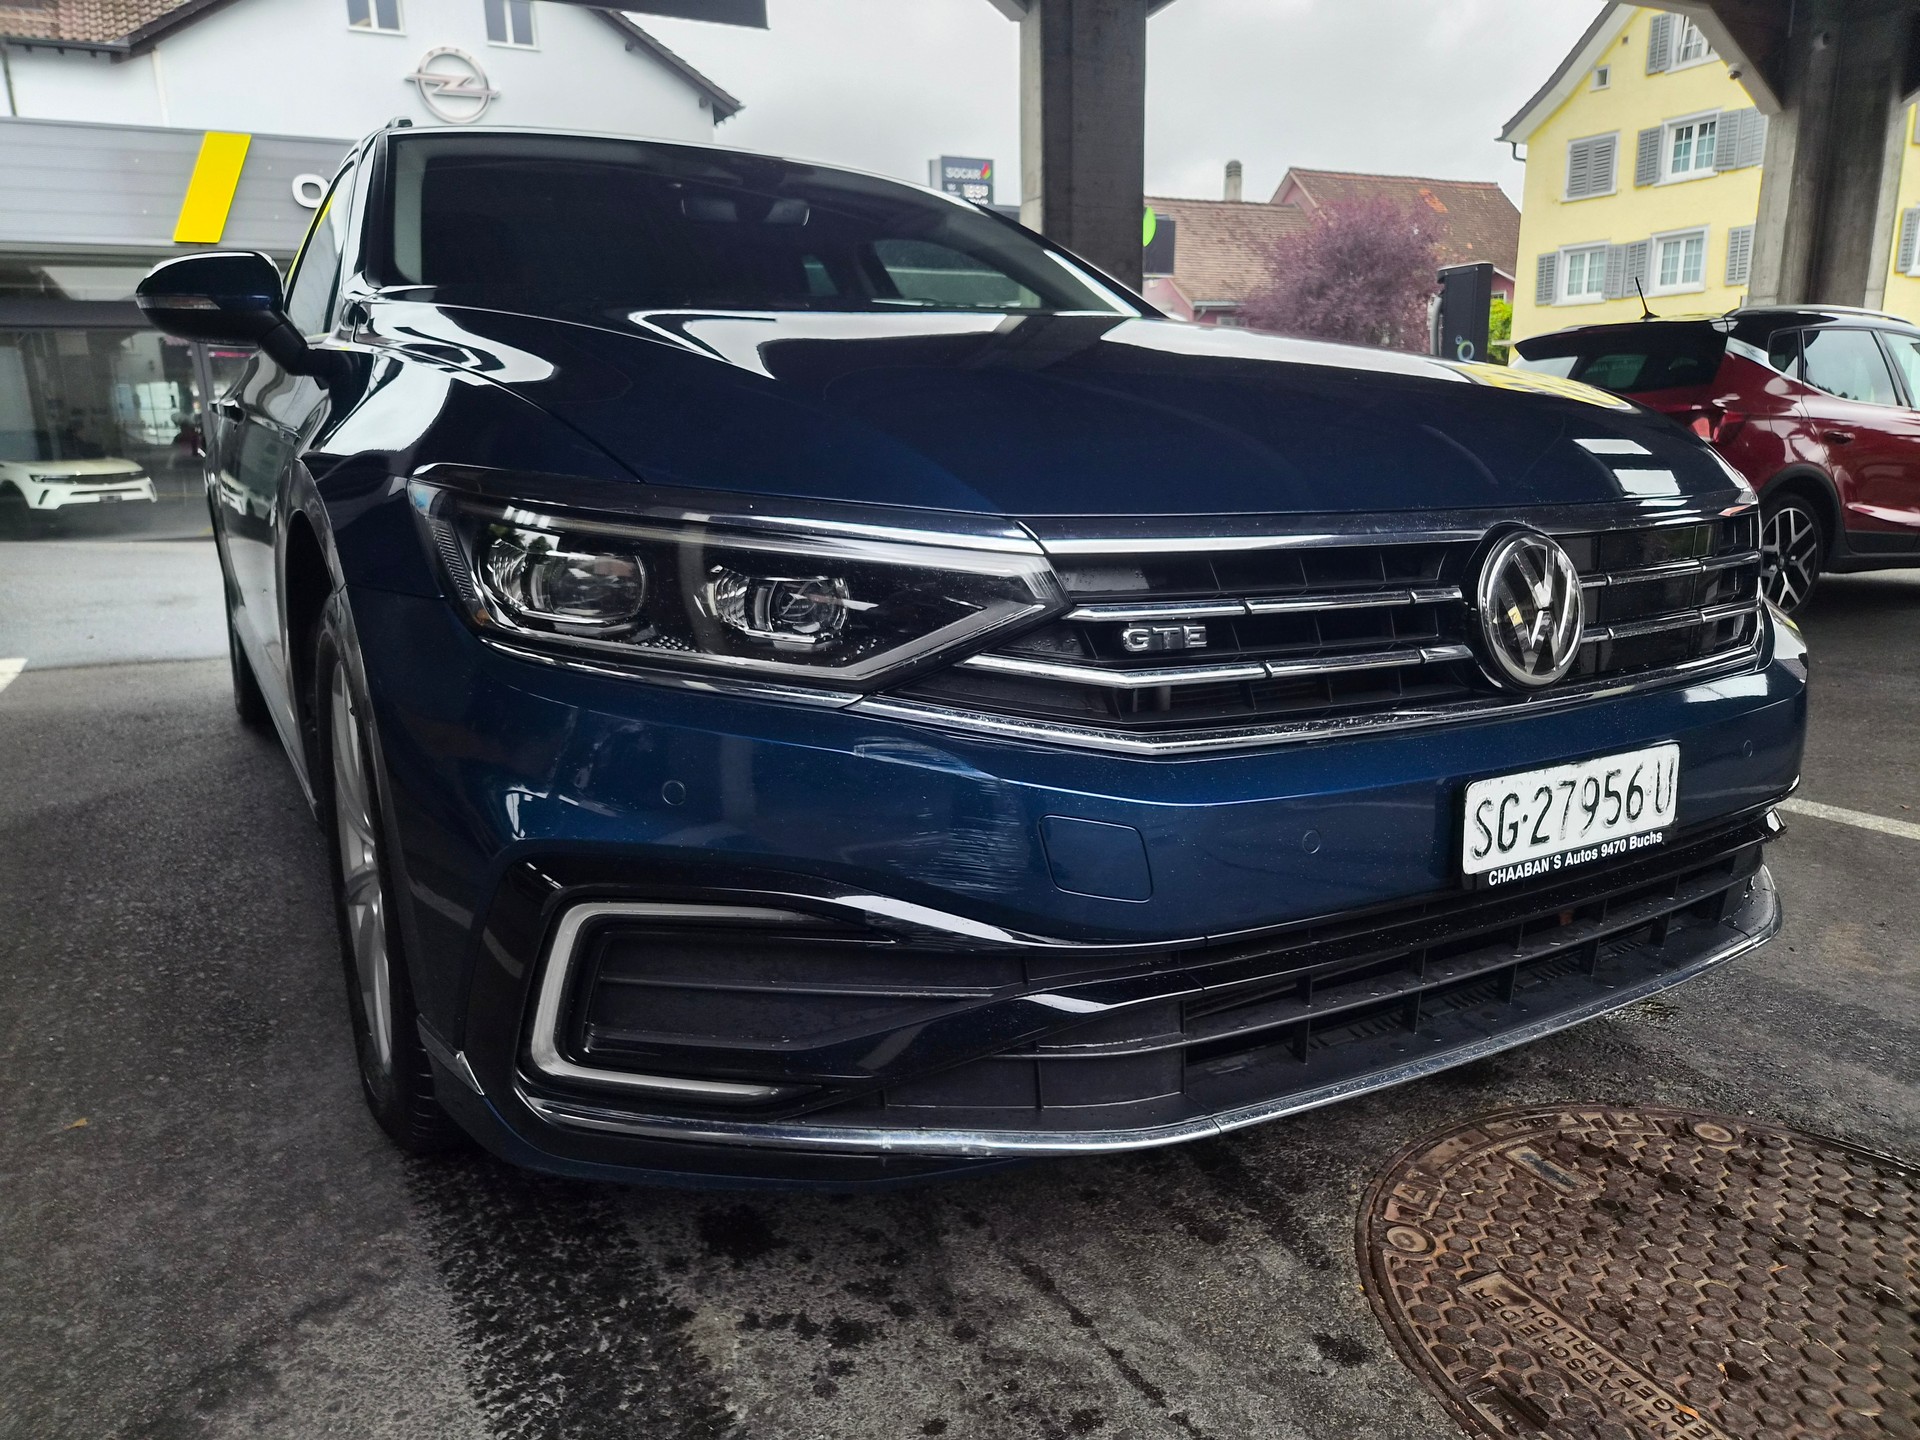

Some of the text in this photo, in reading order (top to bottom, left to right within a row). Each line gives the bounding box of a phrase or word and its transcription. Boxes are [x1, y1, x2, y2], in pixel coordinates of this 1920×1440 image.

[1123, 625, 1207, 652] GTE
[1565, 849, 1598, 867] Autos
[1600, 838, 1627, 857] 9470
[1629, 831, 1663, 850] Buchs
